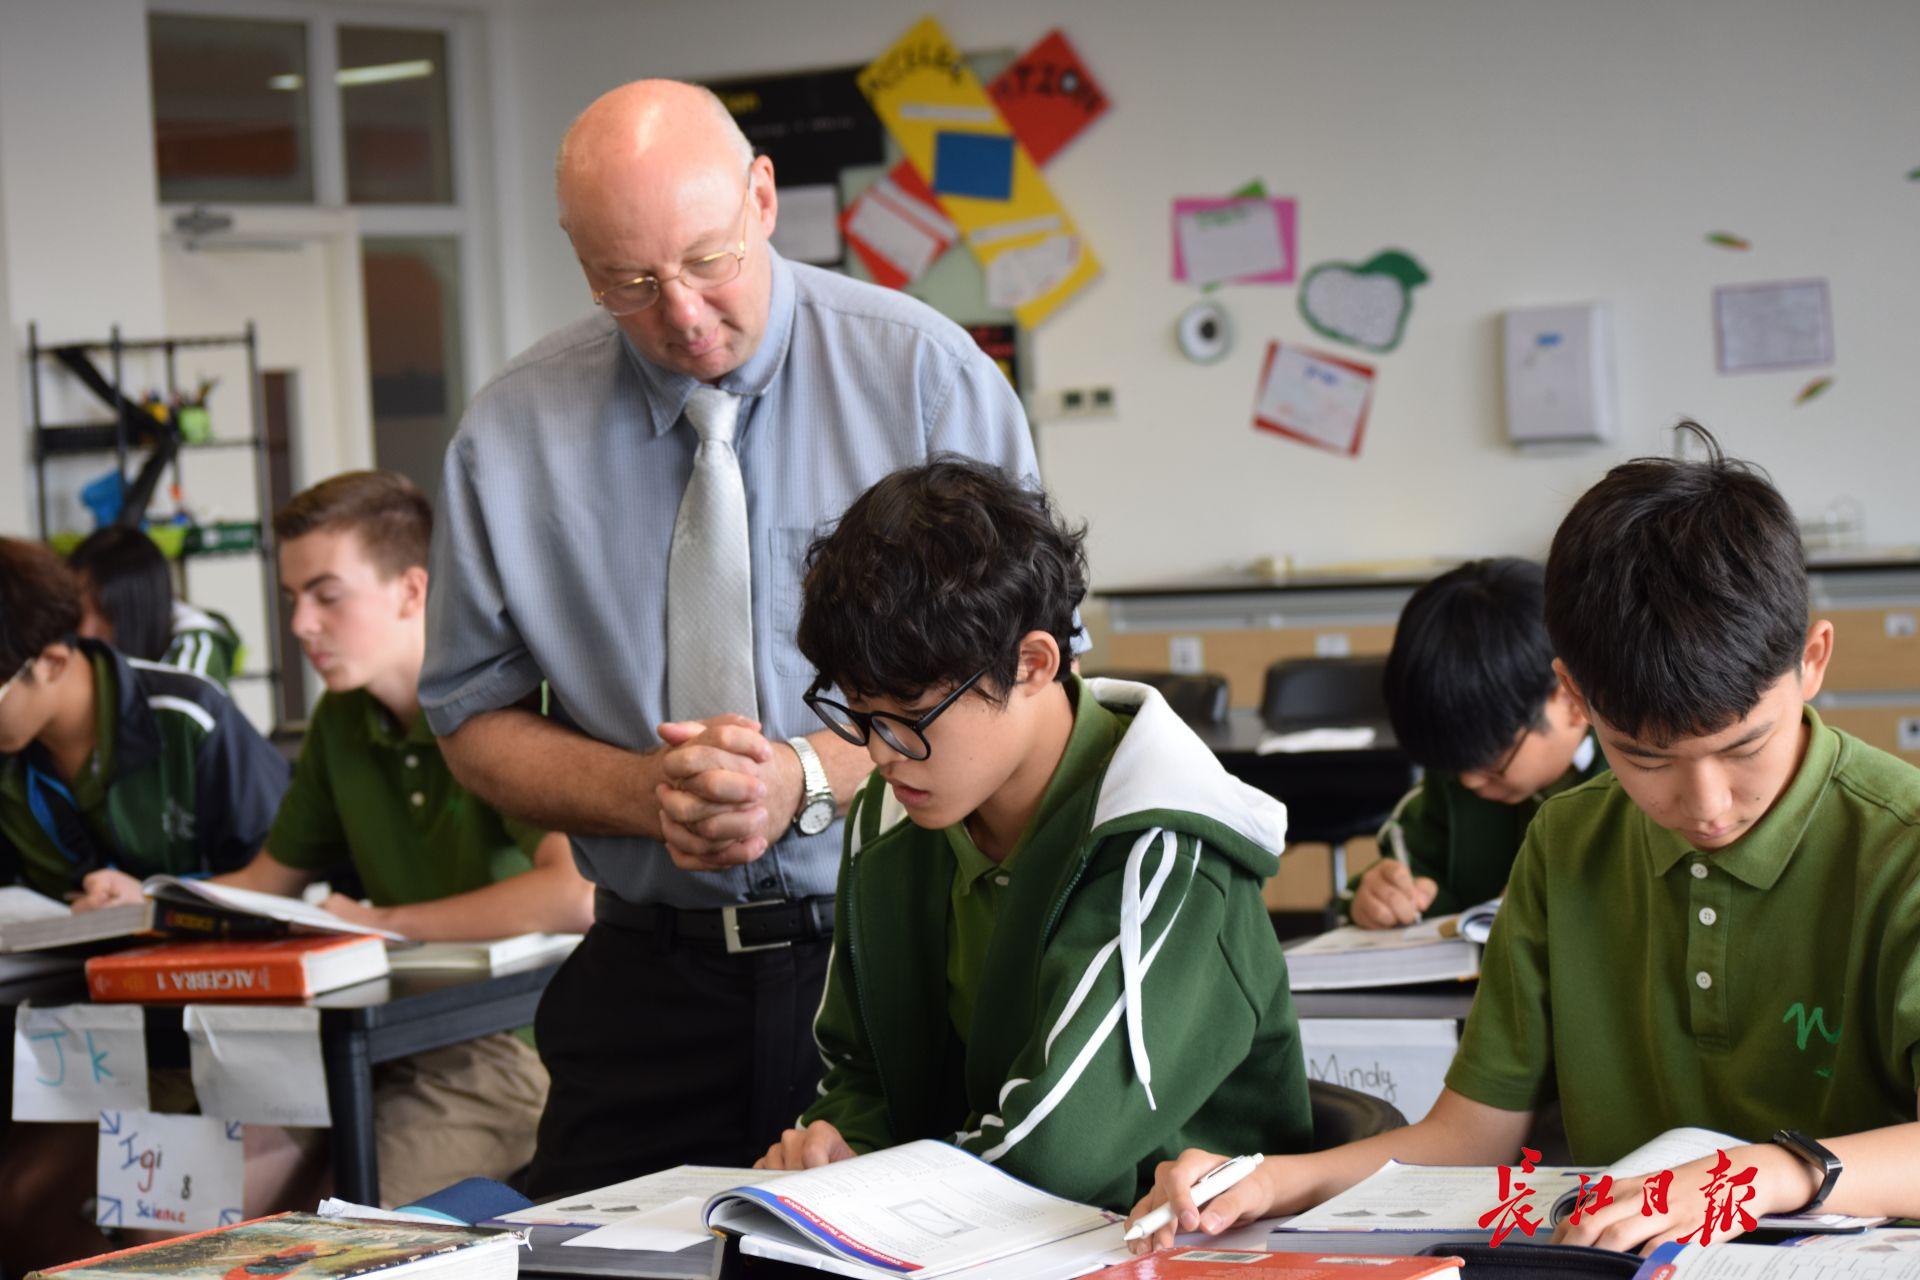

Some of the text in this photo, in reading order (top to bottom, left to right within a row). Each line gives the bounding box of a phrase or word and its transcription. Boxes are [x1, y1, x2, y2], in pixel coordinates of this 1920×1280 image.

[156, 970, 167, 990] 1
[171, 967, 257, 991] ALGEBRA
[1309, 1053, 1398, 1103] Mindy
[180, 1173, 192, 1201] 8
[136, 1199, 187, 1224] Science
